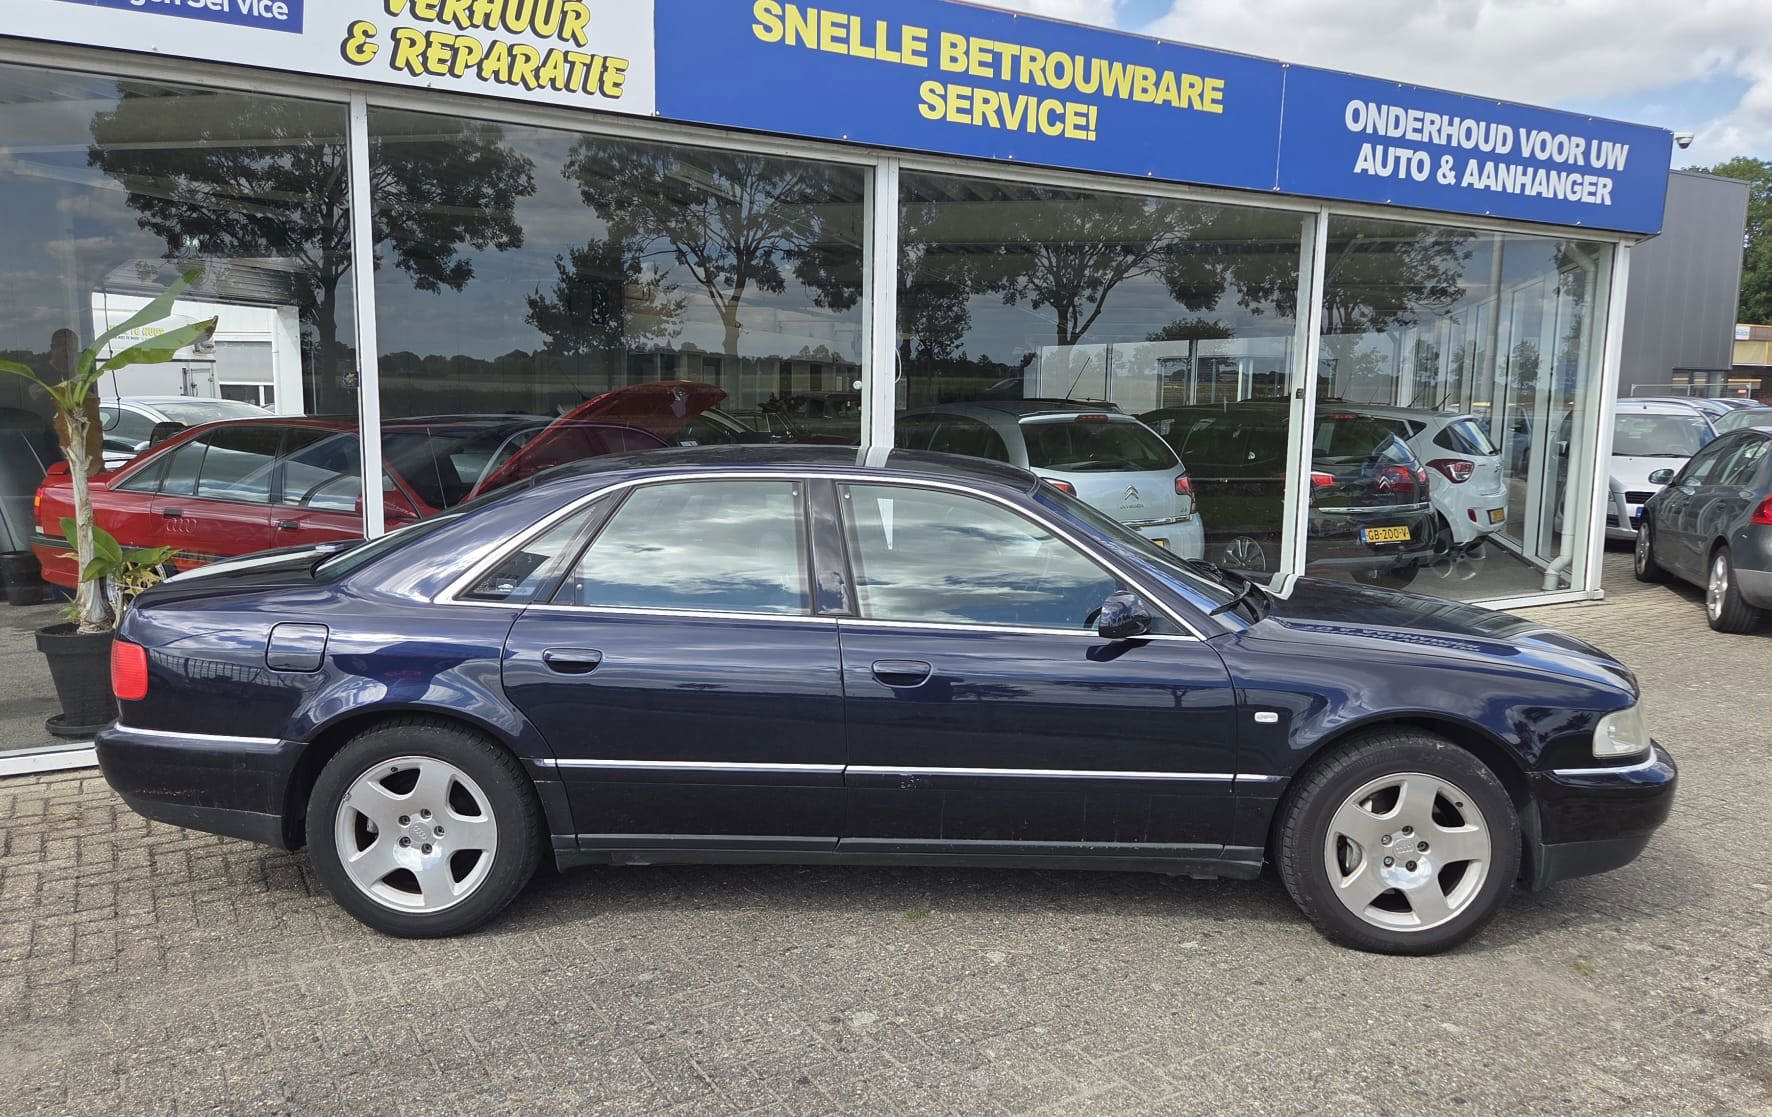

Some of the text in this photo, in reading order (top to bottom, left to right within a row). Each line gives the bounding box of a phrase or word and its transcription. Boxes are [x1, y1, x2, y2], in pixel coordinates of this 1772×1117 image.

[341, 20, 630, 99] & REPARATIE
[752, 0, 1225, 114] SNELLE BETROUWBARE
[919, 80, 1098, 142] SERVICE!
[1345, 99, 1630, 172] ONDERHOUD VOOR UW
[1353, 142, 1613, 206] AUTO & AANHANGER
[1367, 527, 1408, 541] GB-200-V
